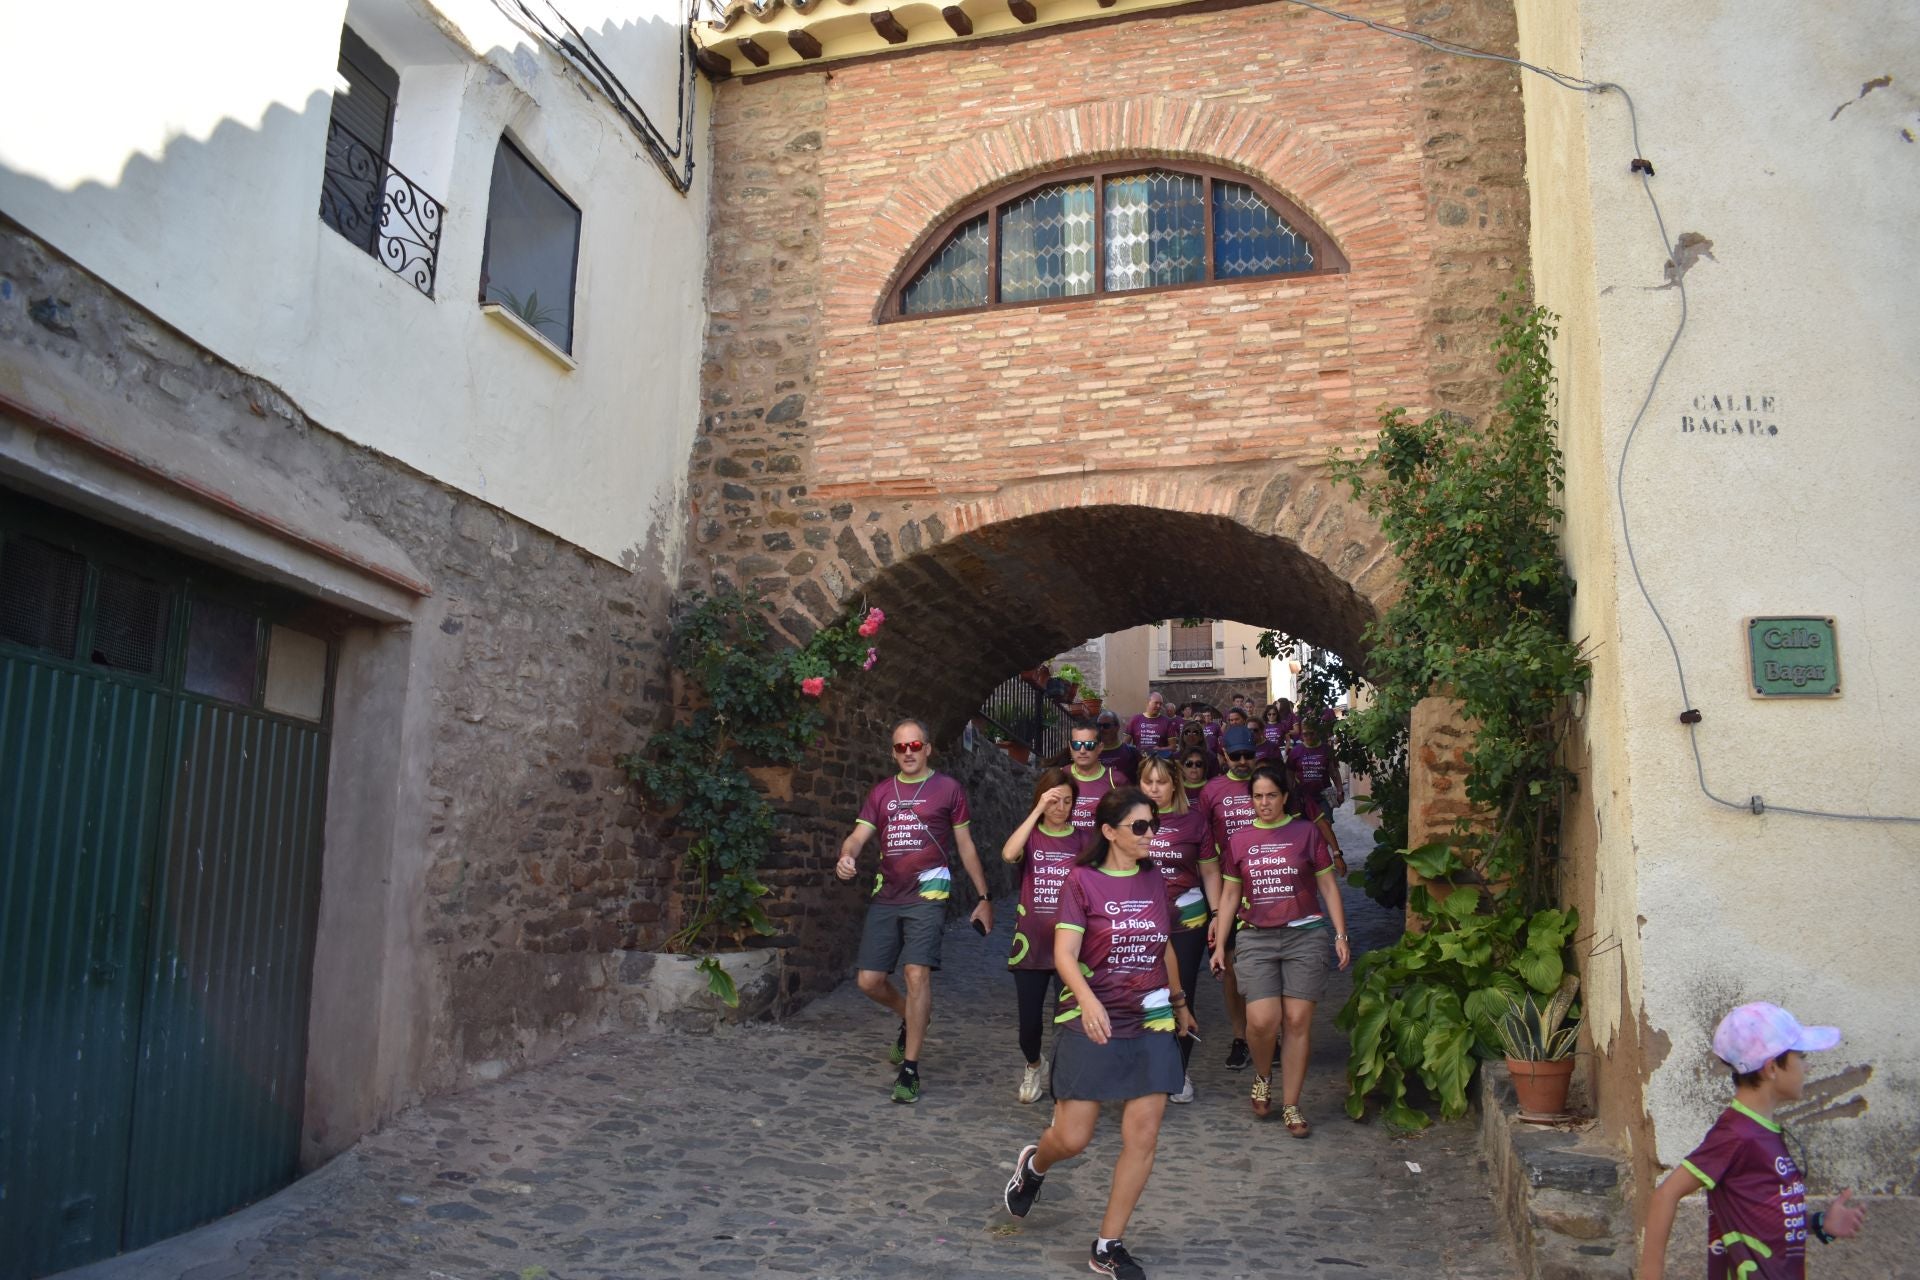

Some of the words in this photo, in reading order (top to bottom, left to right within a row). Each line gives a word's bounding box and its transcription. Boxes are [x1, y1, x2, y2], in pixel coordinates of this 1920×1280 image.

[1693, 394, 1775, 413] CALLE
[1763, 628, 1821, 650] Calle
[1763, 660, 1826, 688] Bagar
[1224, 810, 1234, 818] La
[1225, 819, 1236, 827] En
[887, 831, 912, 840] contra
[1248, 858, 1260, 866] La
[1262, 856, 1287, 865] Rioja
[1034, 865, 1046, 874] La
[1047, 866, 1071, 877] Rioja
[1250, 868, 1262, 877] En
[1263, 866, 1299, 876] marcha
[1034, 876, 1046, 886] En
[1252, 877, 1281, 886] contra
[1252, 886, 1261, 895] el
[1262, 884, 1294, 894] cáncer
[1033, 894, 1042, 903] el
[1111, 919, 1127, 930] La
[1128, 918, 1156, 930] Rioja
[1111, 934, 1127, 945] En
[1128, 932, 1169, 943] marcha
[1110, 943, 1147, 953] contra
[1107, 953, 1120, 964] el
[1779, 1184, 1793, 1196] La
[1782, 1201, 1797, 1214] En
[1785, 1228, 1796, 1241] el
